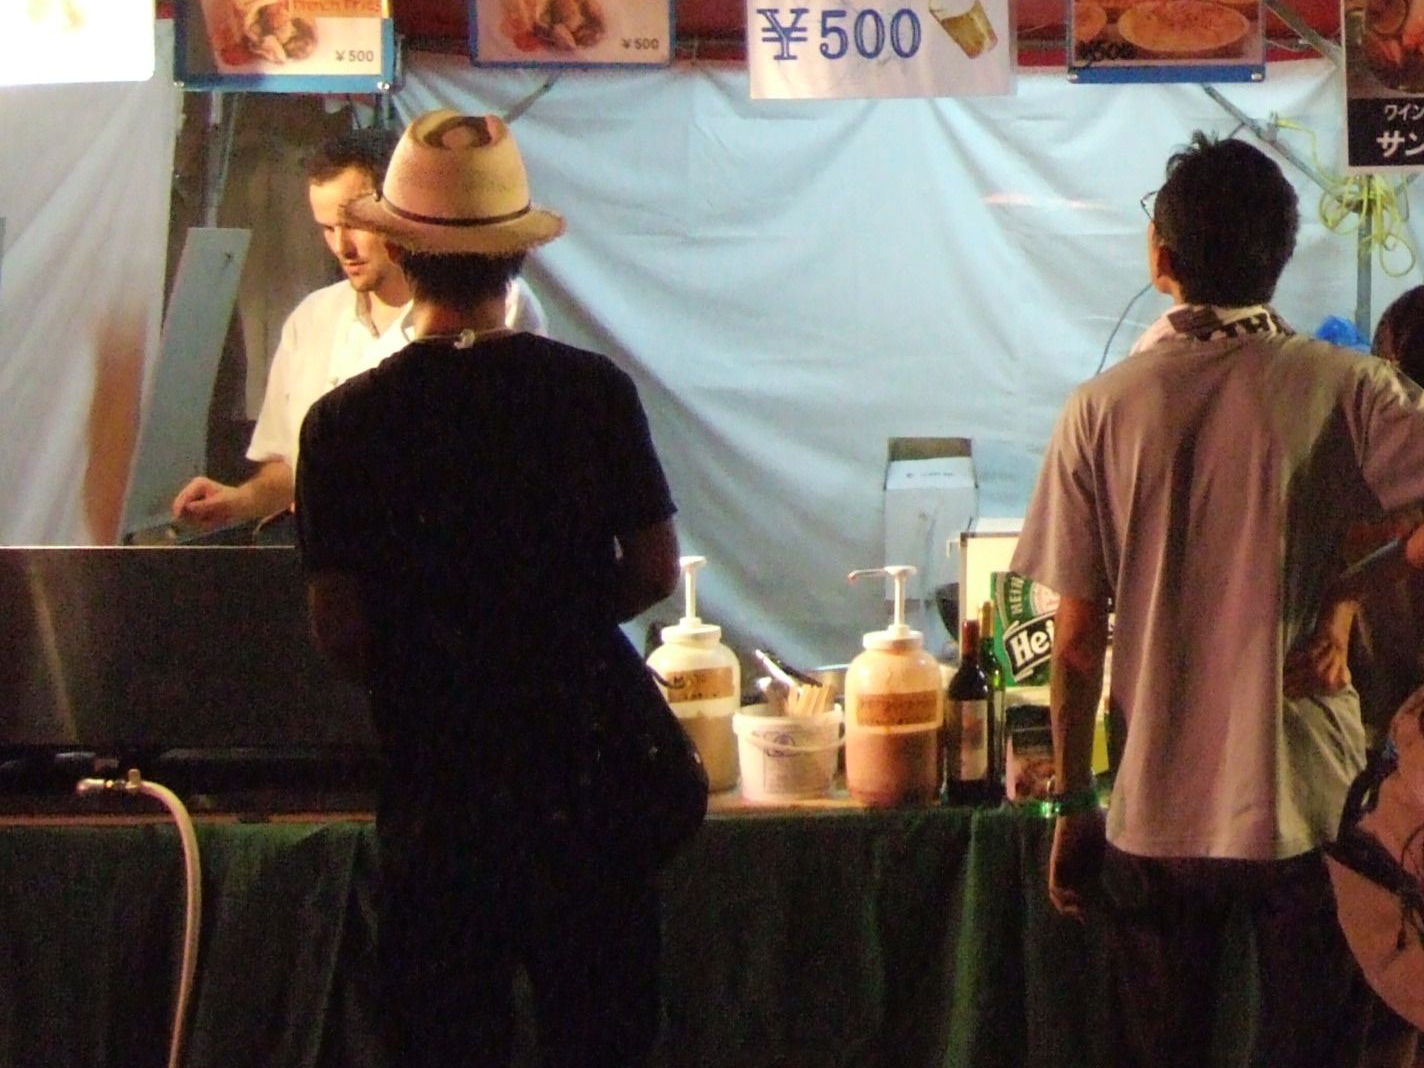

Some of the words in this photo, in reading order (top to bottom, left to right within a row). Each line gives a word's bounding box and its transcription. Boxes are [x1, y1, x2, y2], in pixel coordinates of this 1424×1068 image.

[756, 7, 923, 62] ¥500
[621, 38, 660, 50] ¥500
[334, 49, 375, 62] ¥500
